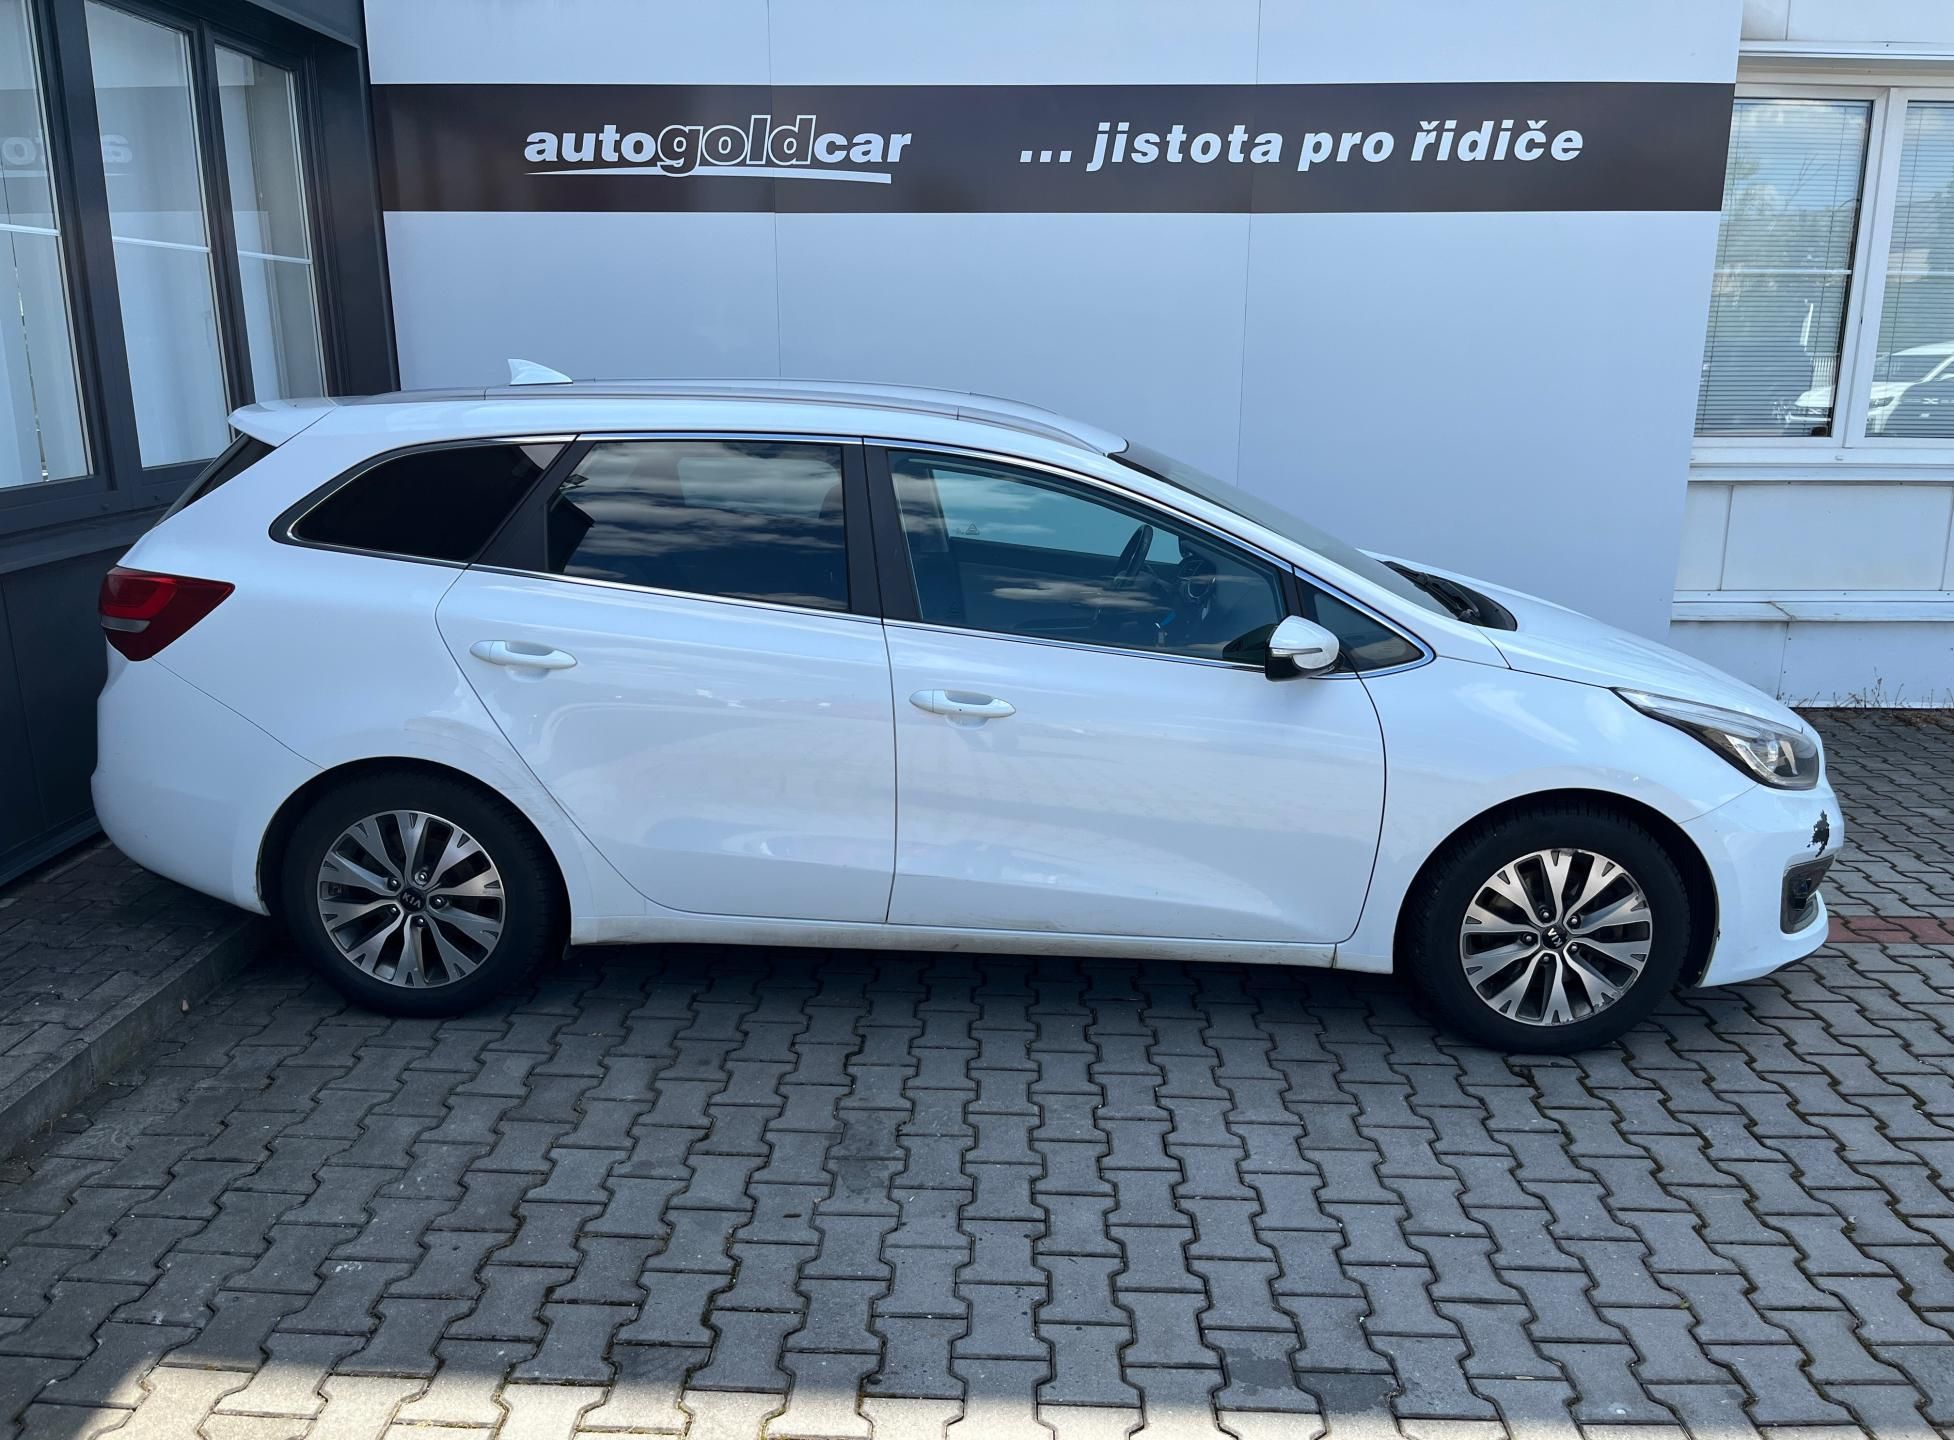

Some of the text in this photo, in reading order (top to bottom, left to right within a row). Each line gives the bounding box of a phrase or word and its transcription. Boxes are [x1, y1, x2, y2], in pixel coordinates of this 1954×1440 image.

[524, 115, 912, 178] autogoldcar
[1086, 122, 1282, 172] jistota
[1297, 131, 1395, 172] pro
[1411, 119, 1584, 162] řidiče
[402, 892, 421, 908] KIA
[1547, 928, 1563, 947] KIA
